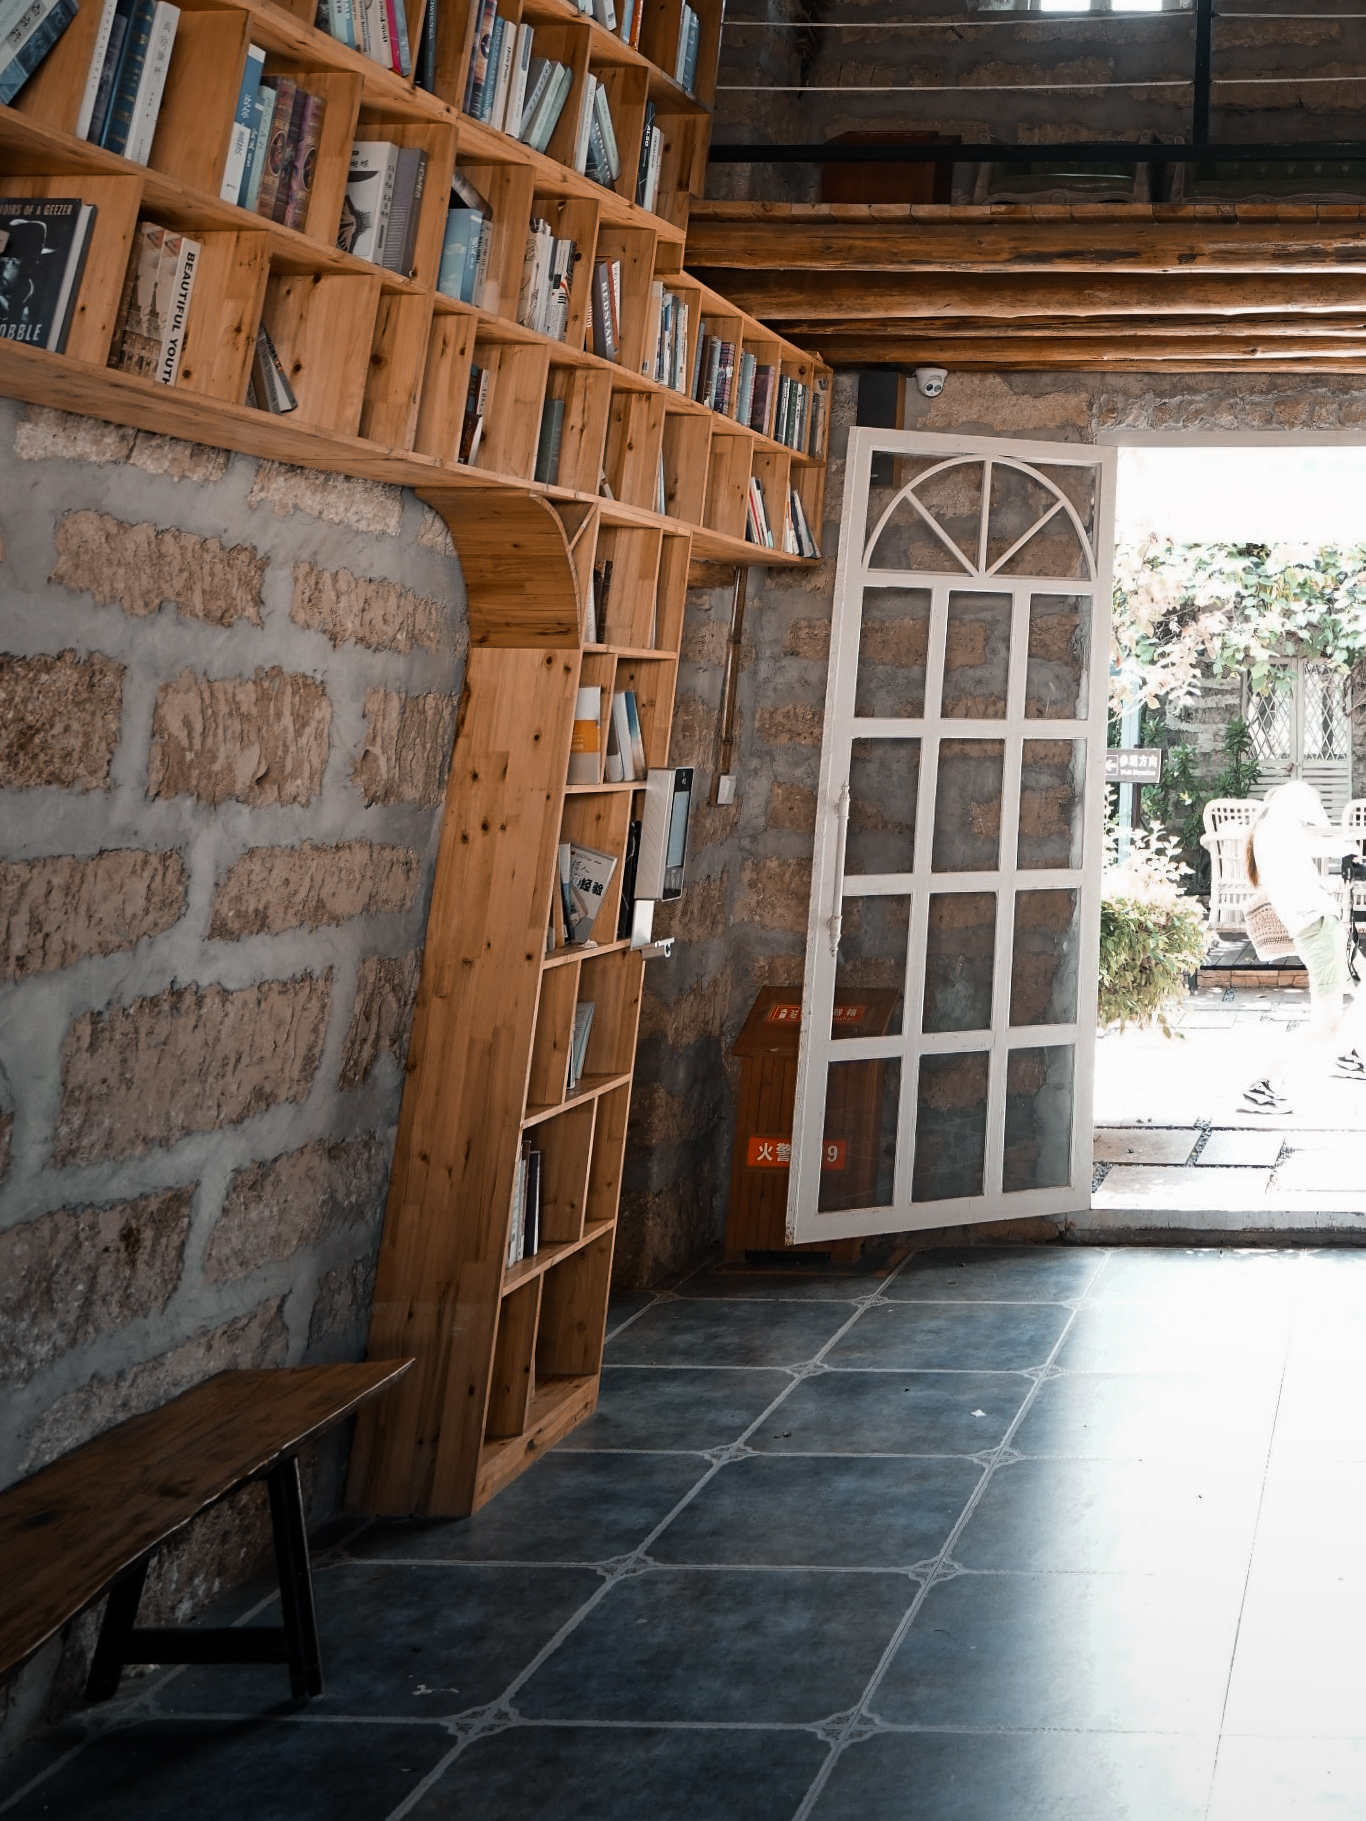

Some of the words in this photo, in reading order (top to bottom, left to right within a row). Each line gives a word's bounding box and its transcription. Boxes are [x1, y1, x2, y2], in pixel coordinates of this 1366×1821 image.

[23, 204, 34, 215] OF
[36, 206, 42, 215] A
[43, 204, 73, 216] GEEZER
[171, 251, 196, 334] BEAUTIFUL
[599, 281, 614, 346] REDSTAR
[756, 1142, 791, 1163] 火警
